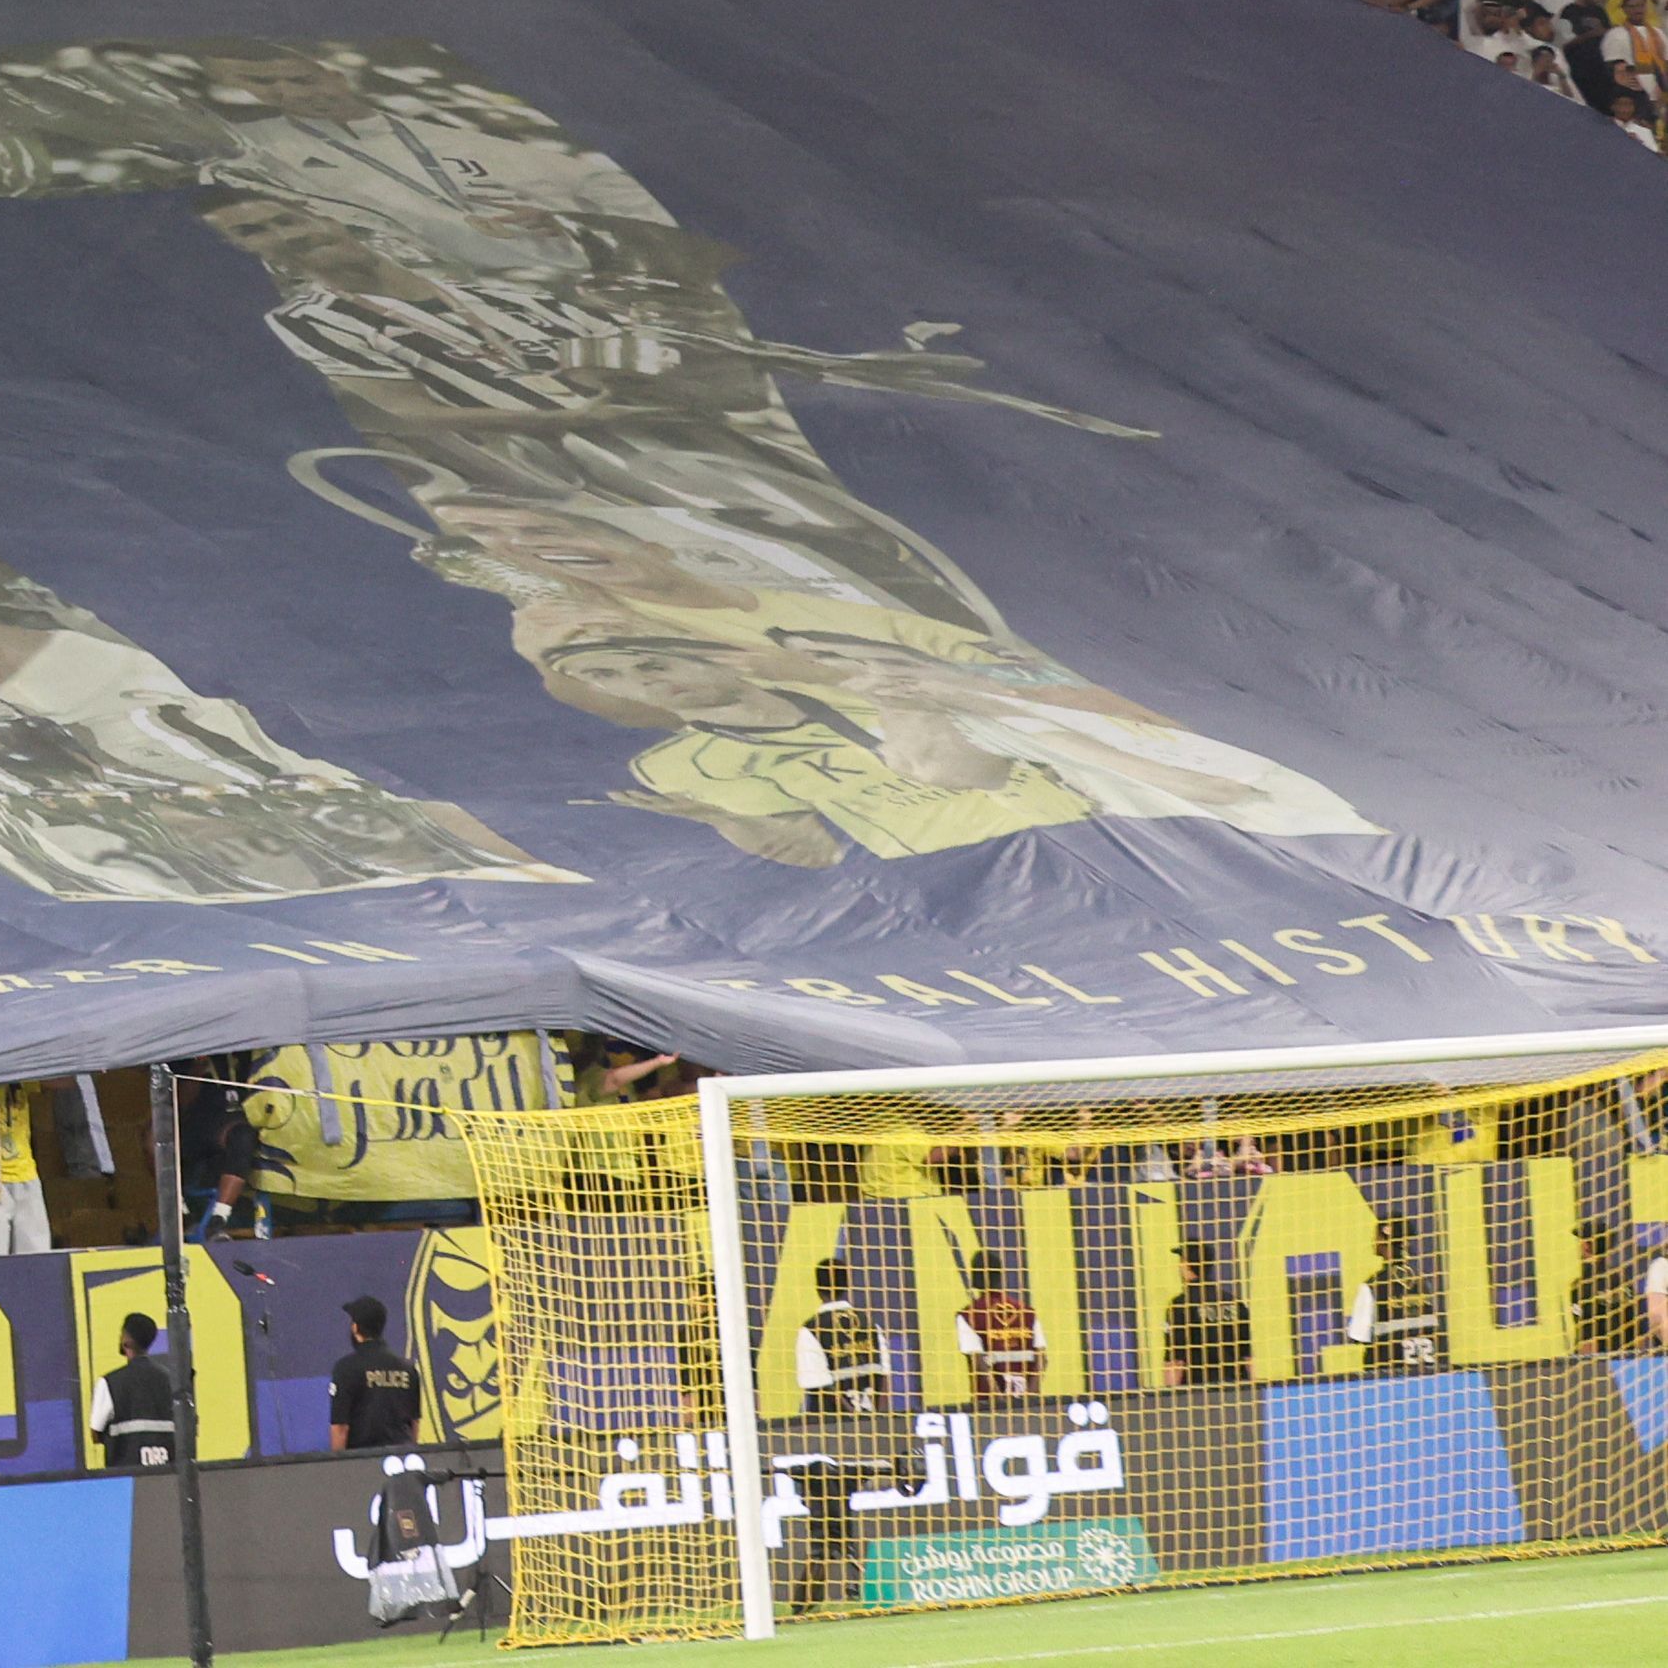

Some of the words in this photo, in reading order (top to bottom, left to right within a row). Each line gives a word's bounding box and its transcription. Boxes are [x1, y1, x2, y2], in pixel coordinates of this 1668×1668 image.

[248, 940, 420, 965] IN
[366, 1370, 410, 1390] POLICE
[908, 1575, 995, 1603] ROSHN
[993, 1566, 1075, 1595] GROUP
